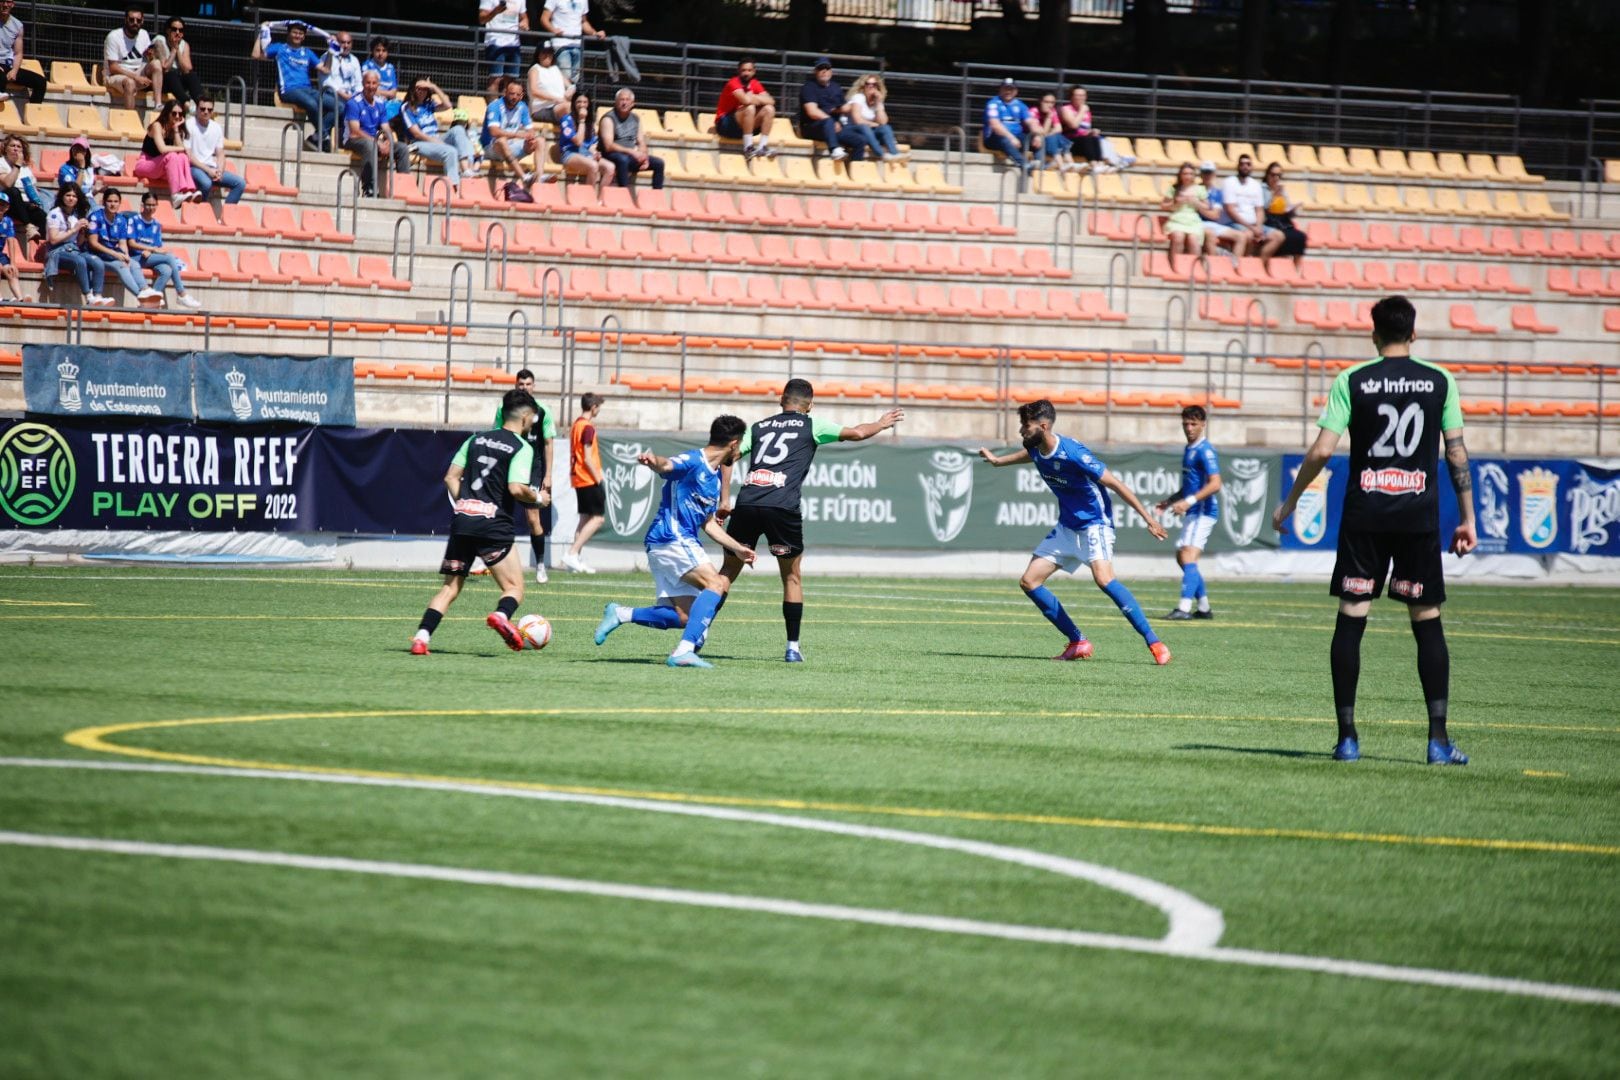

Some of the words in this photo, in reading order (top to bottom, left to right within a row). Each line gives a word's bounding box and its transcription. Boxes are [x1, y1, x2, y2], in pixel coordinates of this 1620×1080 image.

[86, 381, 166, 398] Ayuntamiento
[1384, 377, 1435, 393] Infrico
[90, 400, 105, 411] de
[1367, 402, 1425, 457] 20
[92, 433, 220, 485] TERCERA
[234, 437, 297, 486] RFEF
[754, 431, 798, 464] 15
[20, 458, 47, 472] RF
[470, 455, 498, 490] 7
[802, 459, 877, 489] RACIÓN
[21, 476, 47, 489] EF
[93, 492, 179, 518] PLAY
[188, 493, 257, 519] OFF
[264, 494, 297, 519] 2022
[823, 493, 897, 523] FÚTBOL
[996, 502, 1058, 526] ANDAL
